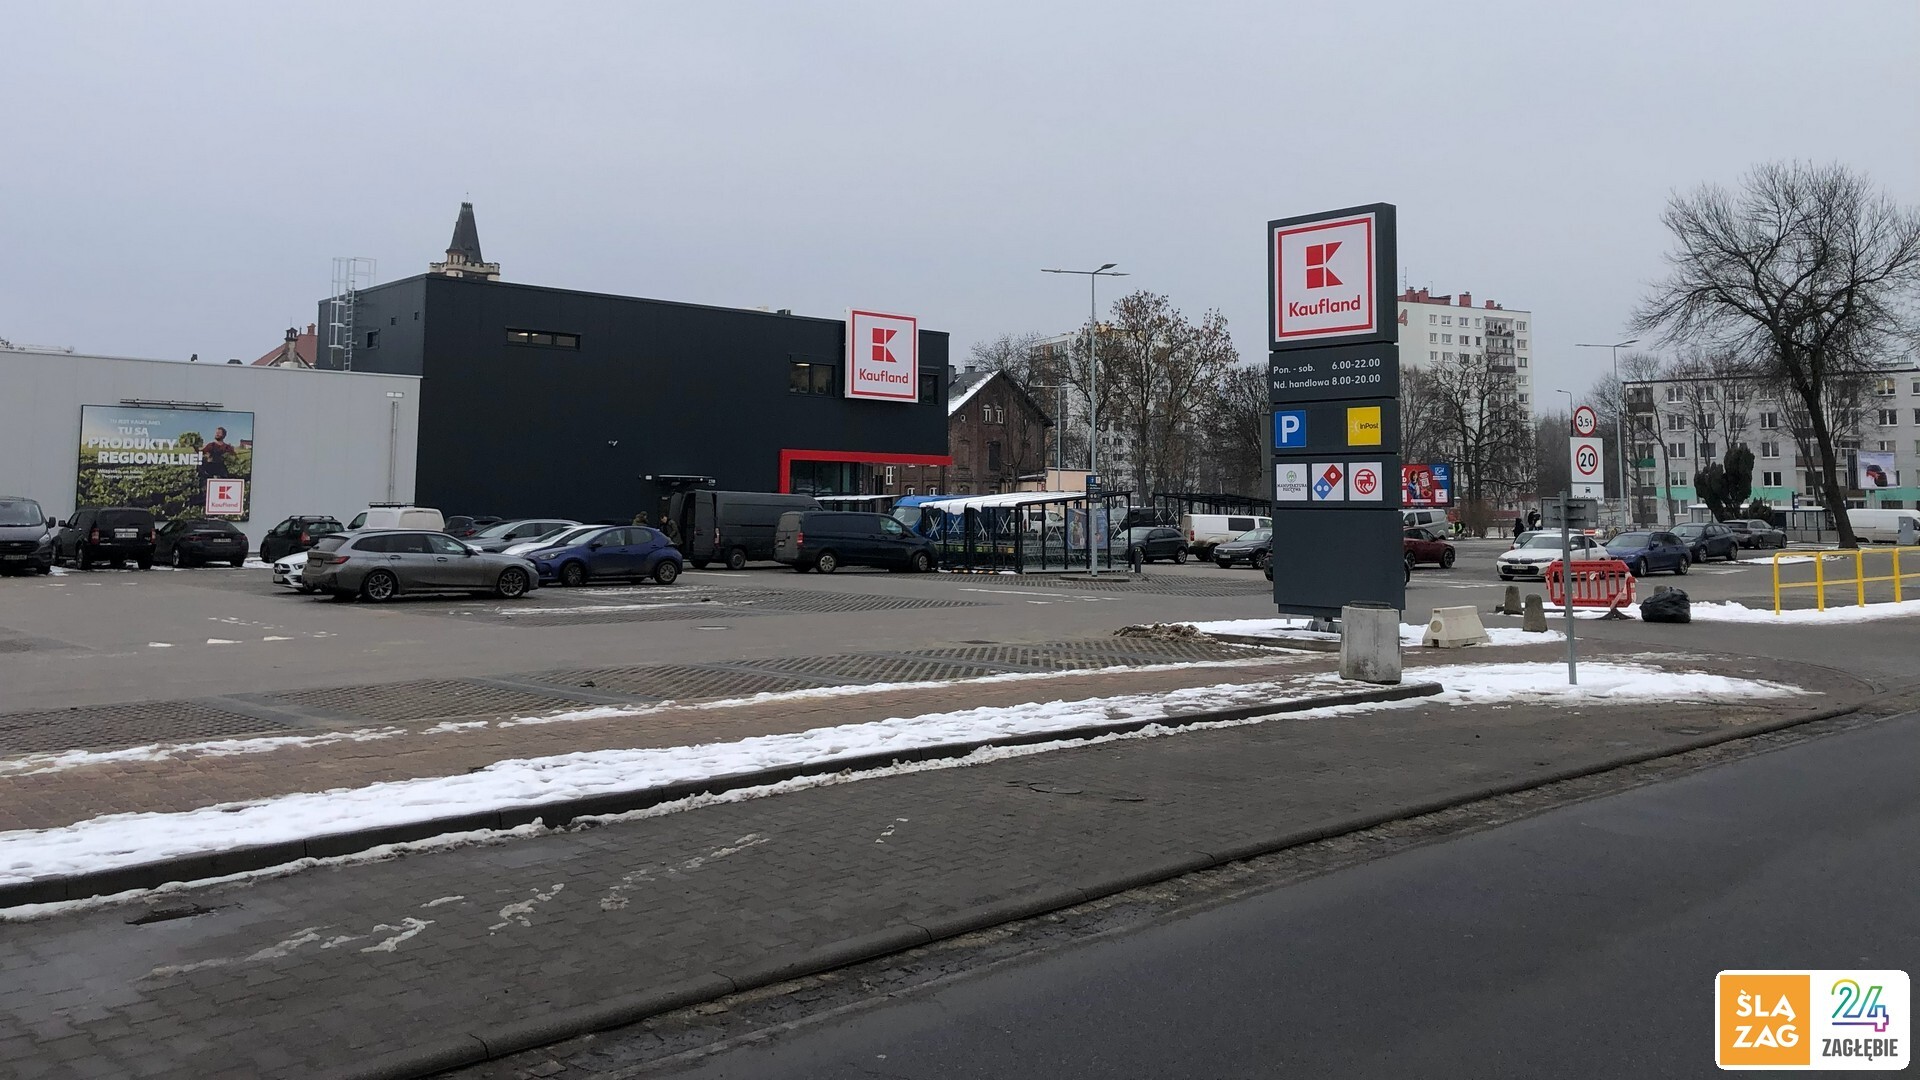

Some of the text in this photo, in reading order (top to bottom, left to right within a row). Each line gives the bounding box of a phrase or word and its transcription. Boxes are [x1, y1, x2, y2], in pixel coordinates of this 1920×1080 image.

[1289, 295, 1360, 317] Kaufland
[1273, 365, 1291, 374] Pon.
[1298, 363, 1315, 373] sob.
[1331, 358, 1380, 370] 6.00-22.00
[859, 368, 909, 384] Kaufland
[1273, 374, 1381, 389] Nd. handlowa 8.00-20.00
[117, 426, 149, 437] TU SĄ
[1281, 415, 1300, 443] P
[88, 437, 177, 451] PRODUKTY
[97, 451, 203, 466] REGIONALNE!
[1580, 453, 1595, 467] 20
